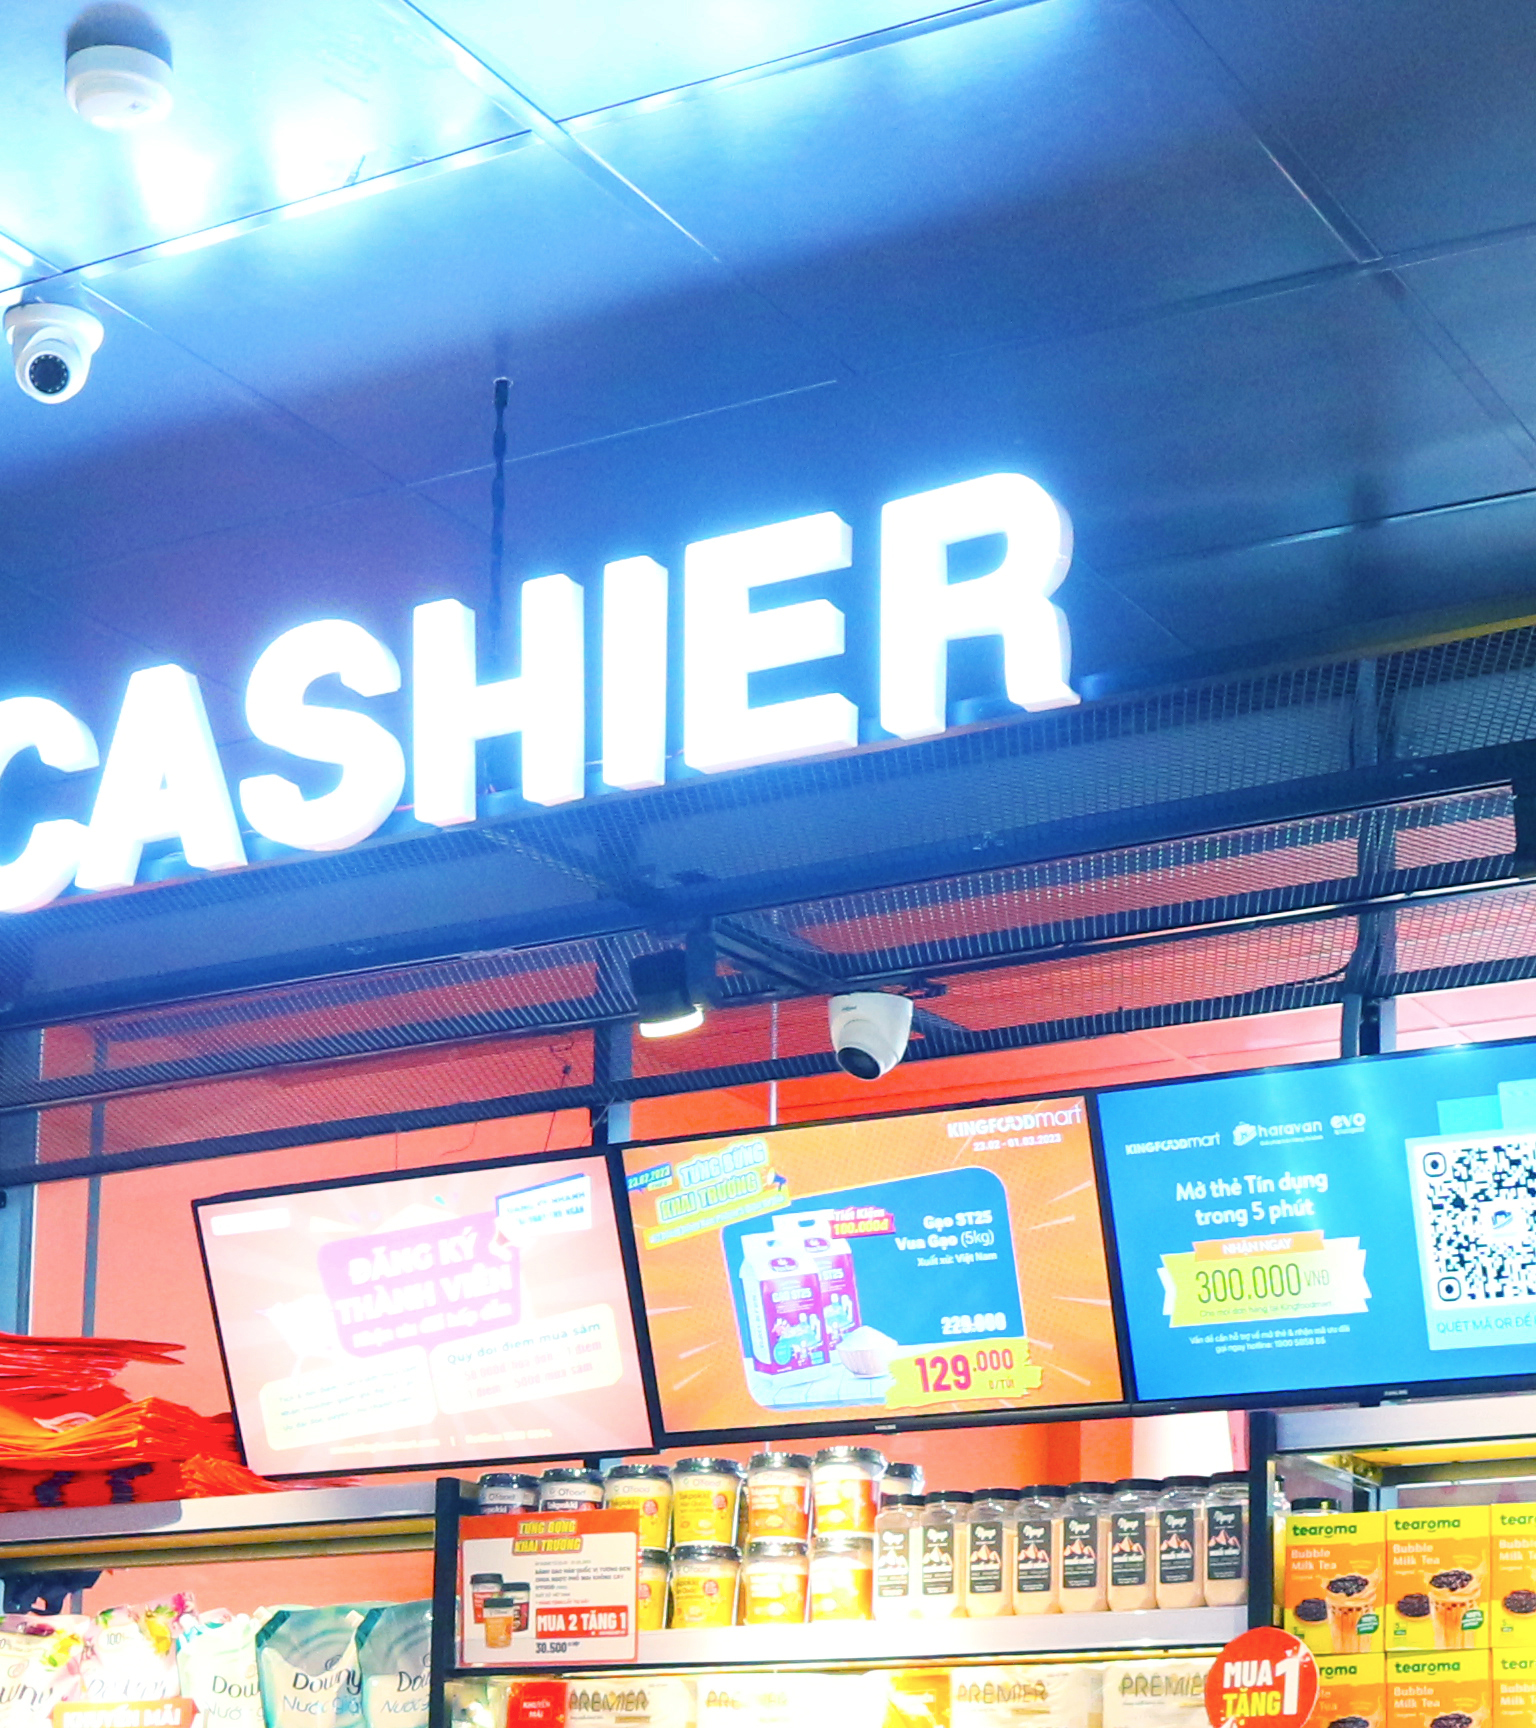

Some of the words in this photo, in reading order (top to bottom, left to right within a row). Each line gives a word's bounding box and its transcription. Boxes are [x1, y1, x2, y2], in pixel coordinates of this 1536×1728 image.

[1330, 1113, 1366, 1129] evo
[1176, 1181, 1207, 1201] Mở
[1210, 1177, 1242, 1198] thẻ
[1244, 1175, 1275, 1194] Tín
[1278, 1172, 1328, 1195] dụng
[661, 1193, 697, 1220] KHAI
[1195, 1208, 1248, 1227] trong
[1251, 1201, 1265, 1221] 5
[1269, 1198, 1315, 1224] phút
[923, 1216, 953, 1232] Gạo
[955, 1210, 992, 1226] ST25
[928, 1234, 958, 1250] Gạo
[960, 1229, 994, 1248] (5kg)
[348, 1243, 434, 1285] ĐĂNG
[438, 1226, 478, 1263] KÝ
[975, 1251, 997, 1262] Nam
[335, 1280, 437, 1326] THÀNH
[440, 1261, 512, 1303] VIÊN
[1195, 1263, 1302, 1304] 300.000
[1303, 1269, 1330, 1286] VNĐ
[1494, 1317, 1514, 1331] QR
[1293, 1523, 1358, 1538] tearoma
[1394, 1518, 1460, 1533] tearoma
[1291, 1549, 1331, 1559] Bubble
[1393, 1543, 1433, 1554] Bubble
[1499, 1550, 1524, 1561] Milk
[1292, 1560, 1314, 1571] Milk
[1319, 1560, 1337, 1571] Tea
[1393, 1555, 1416, 1566] Milk
[1421, 1555, 1440, 1566] Tea
[537, 1614, 565, 1632] MUA
[568, 1613, 578, 1630] 2
[620, 1611, 626, 1629] 1
[1223, 1660, 1273, 1688] MUA
[1394, 1661, 1461, 1676] tearoma
[292, 1668, 363, 1696] Downy
[957, 1680, 1048, 1704] PREMIER
[1119, 1672, 1207, 1697] PREMIE
[1275, 1657, 1300, 1715] 1
[1394, 1686, 1434, 1696] Bubble
[568, 1689, 649, 1712] PREMIER
[1394, 1698, 1417, 1709] Milk
[1422, 1698, 1440, 1708] Tea
[1500, 1694, 1525, 1705] Milk
